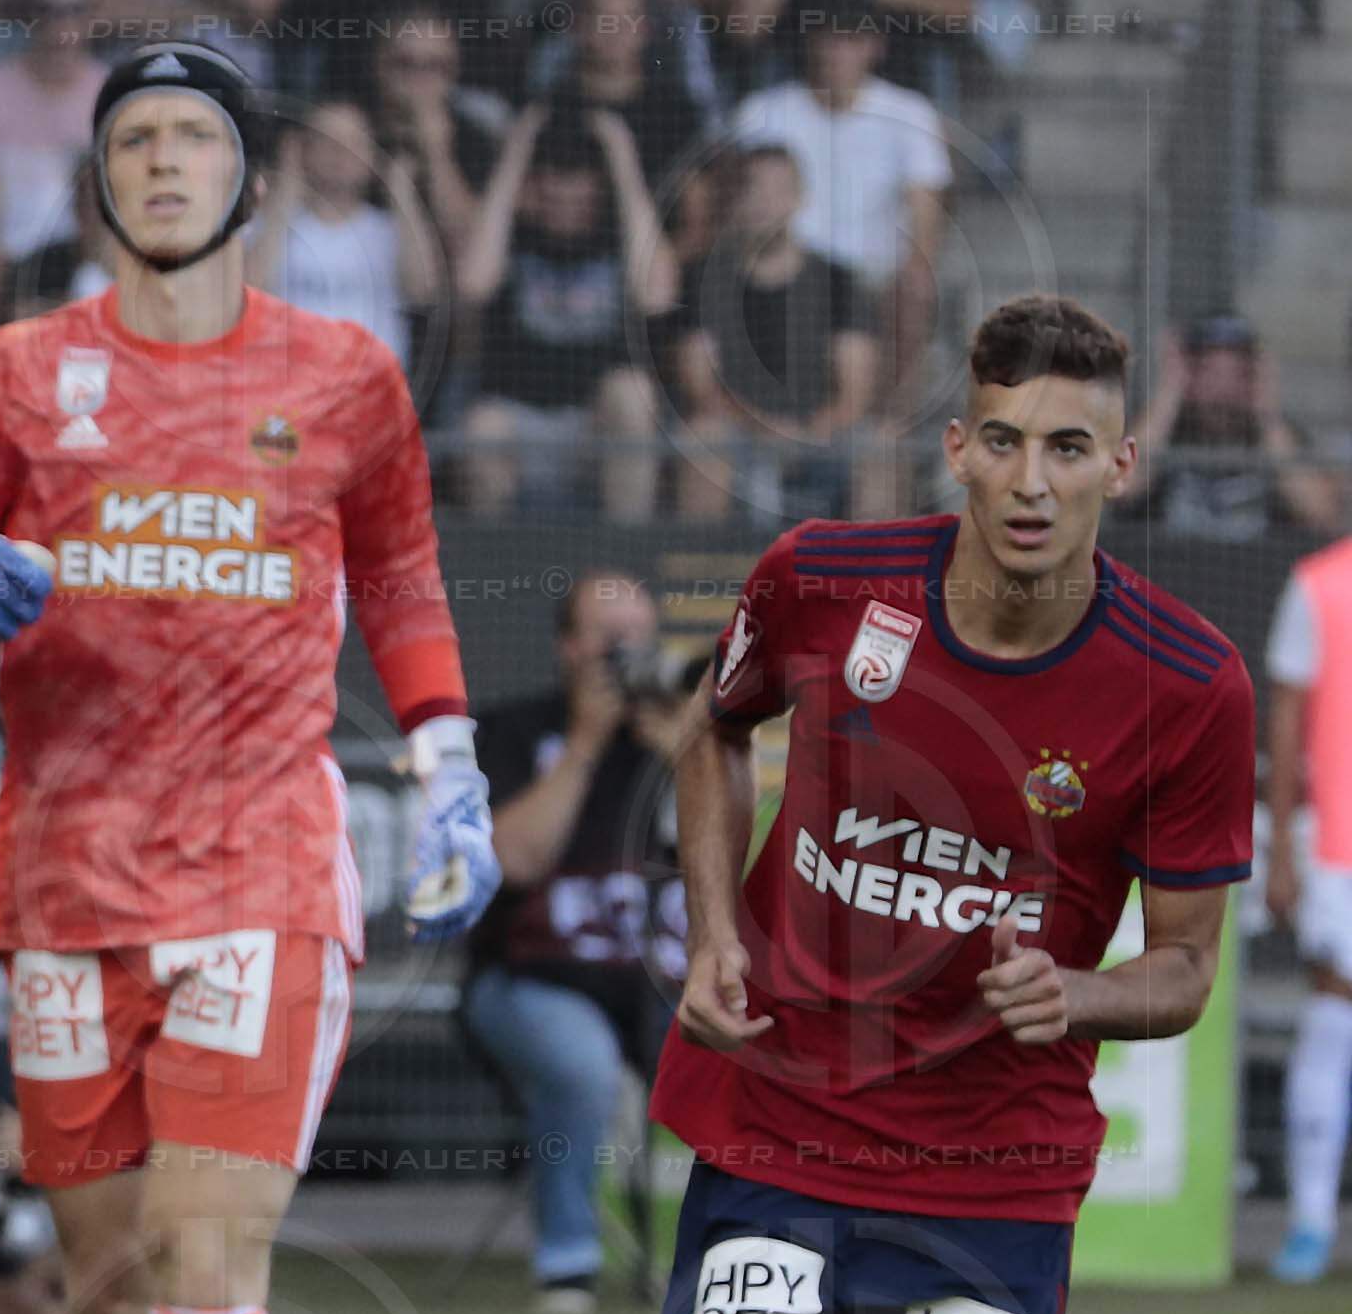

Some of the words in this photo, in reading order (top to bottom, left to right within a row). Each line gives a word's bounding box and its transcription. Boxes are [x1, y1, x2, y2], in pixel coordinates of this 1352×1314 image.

[101, 490, 257, 544] WIEN
[59, 539, 293, 600] ENERGIE
[834, 806, 1012, 881] WIEN
[794, 827, 1047, 934] ENERGIE
[702, 1262, 808, 1305] HPY
